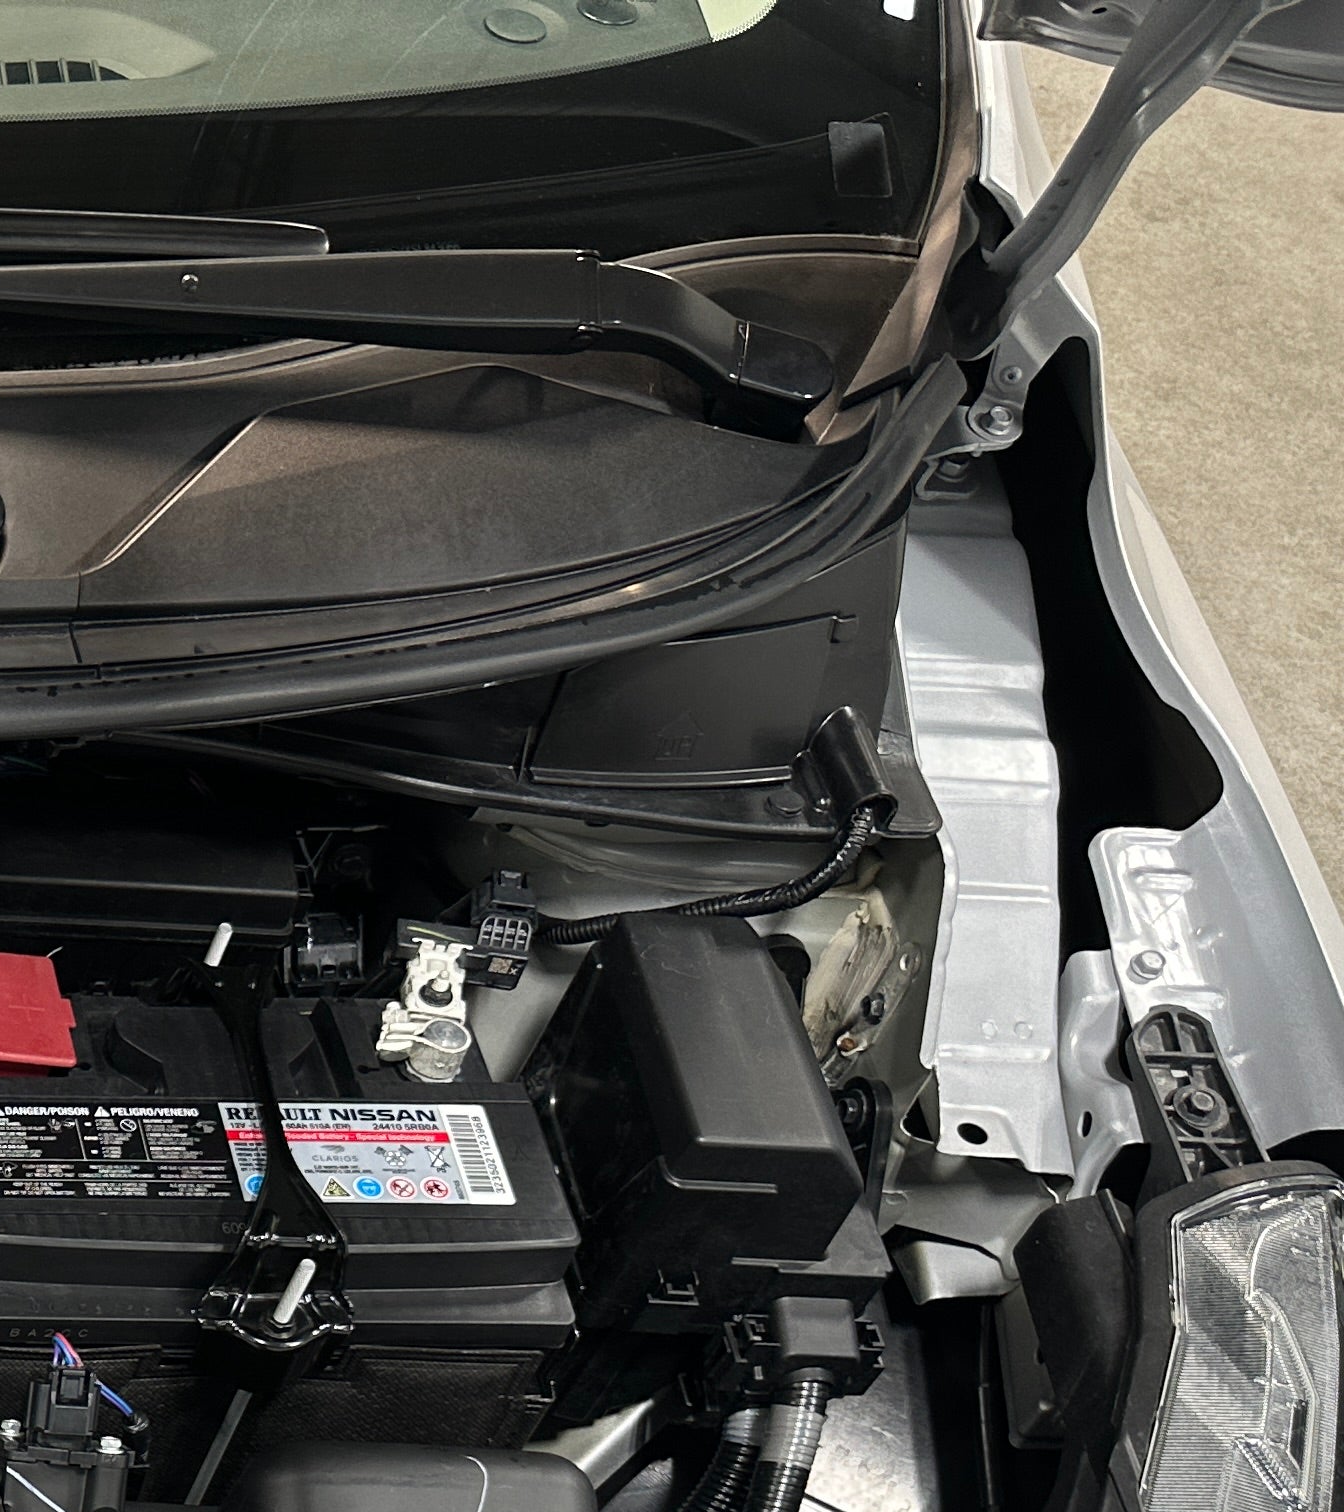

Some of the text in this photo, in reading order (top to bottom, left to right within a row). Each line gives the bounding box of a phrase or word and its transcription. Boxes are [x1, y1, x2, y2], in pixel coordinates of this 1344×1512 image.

[4, 1106, 90, 1116] DANGER/POISON
[110, 1107, 200, 1117] PELIGRO/VENENO
[225, 1107, 437, 1122] REULT NISSAN
[372, 1123, 403, 1131] 24410
[311, 1154, 360, 1163] CLARIOS
